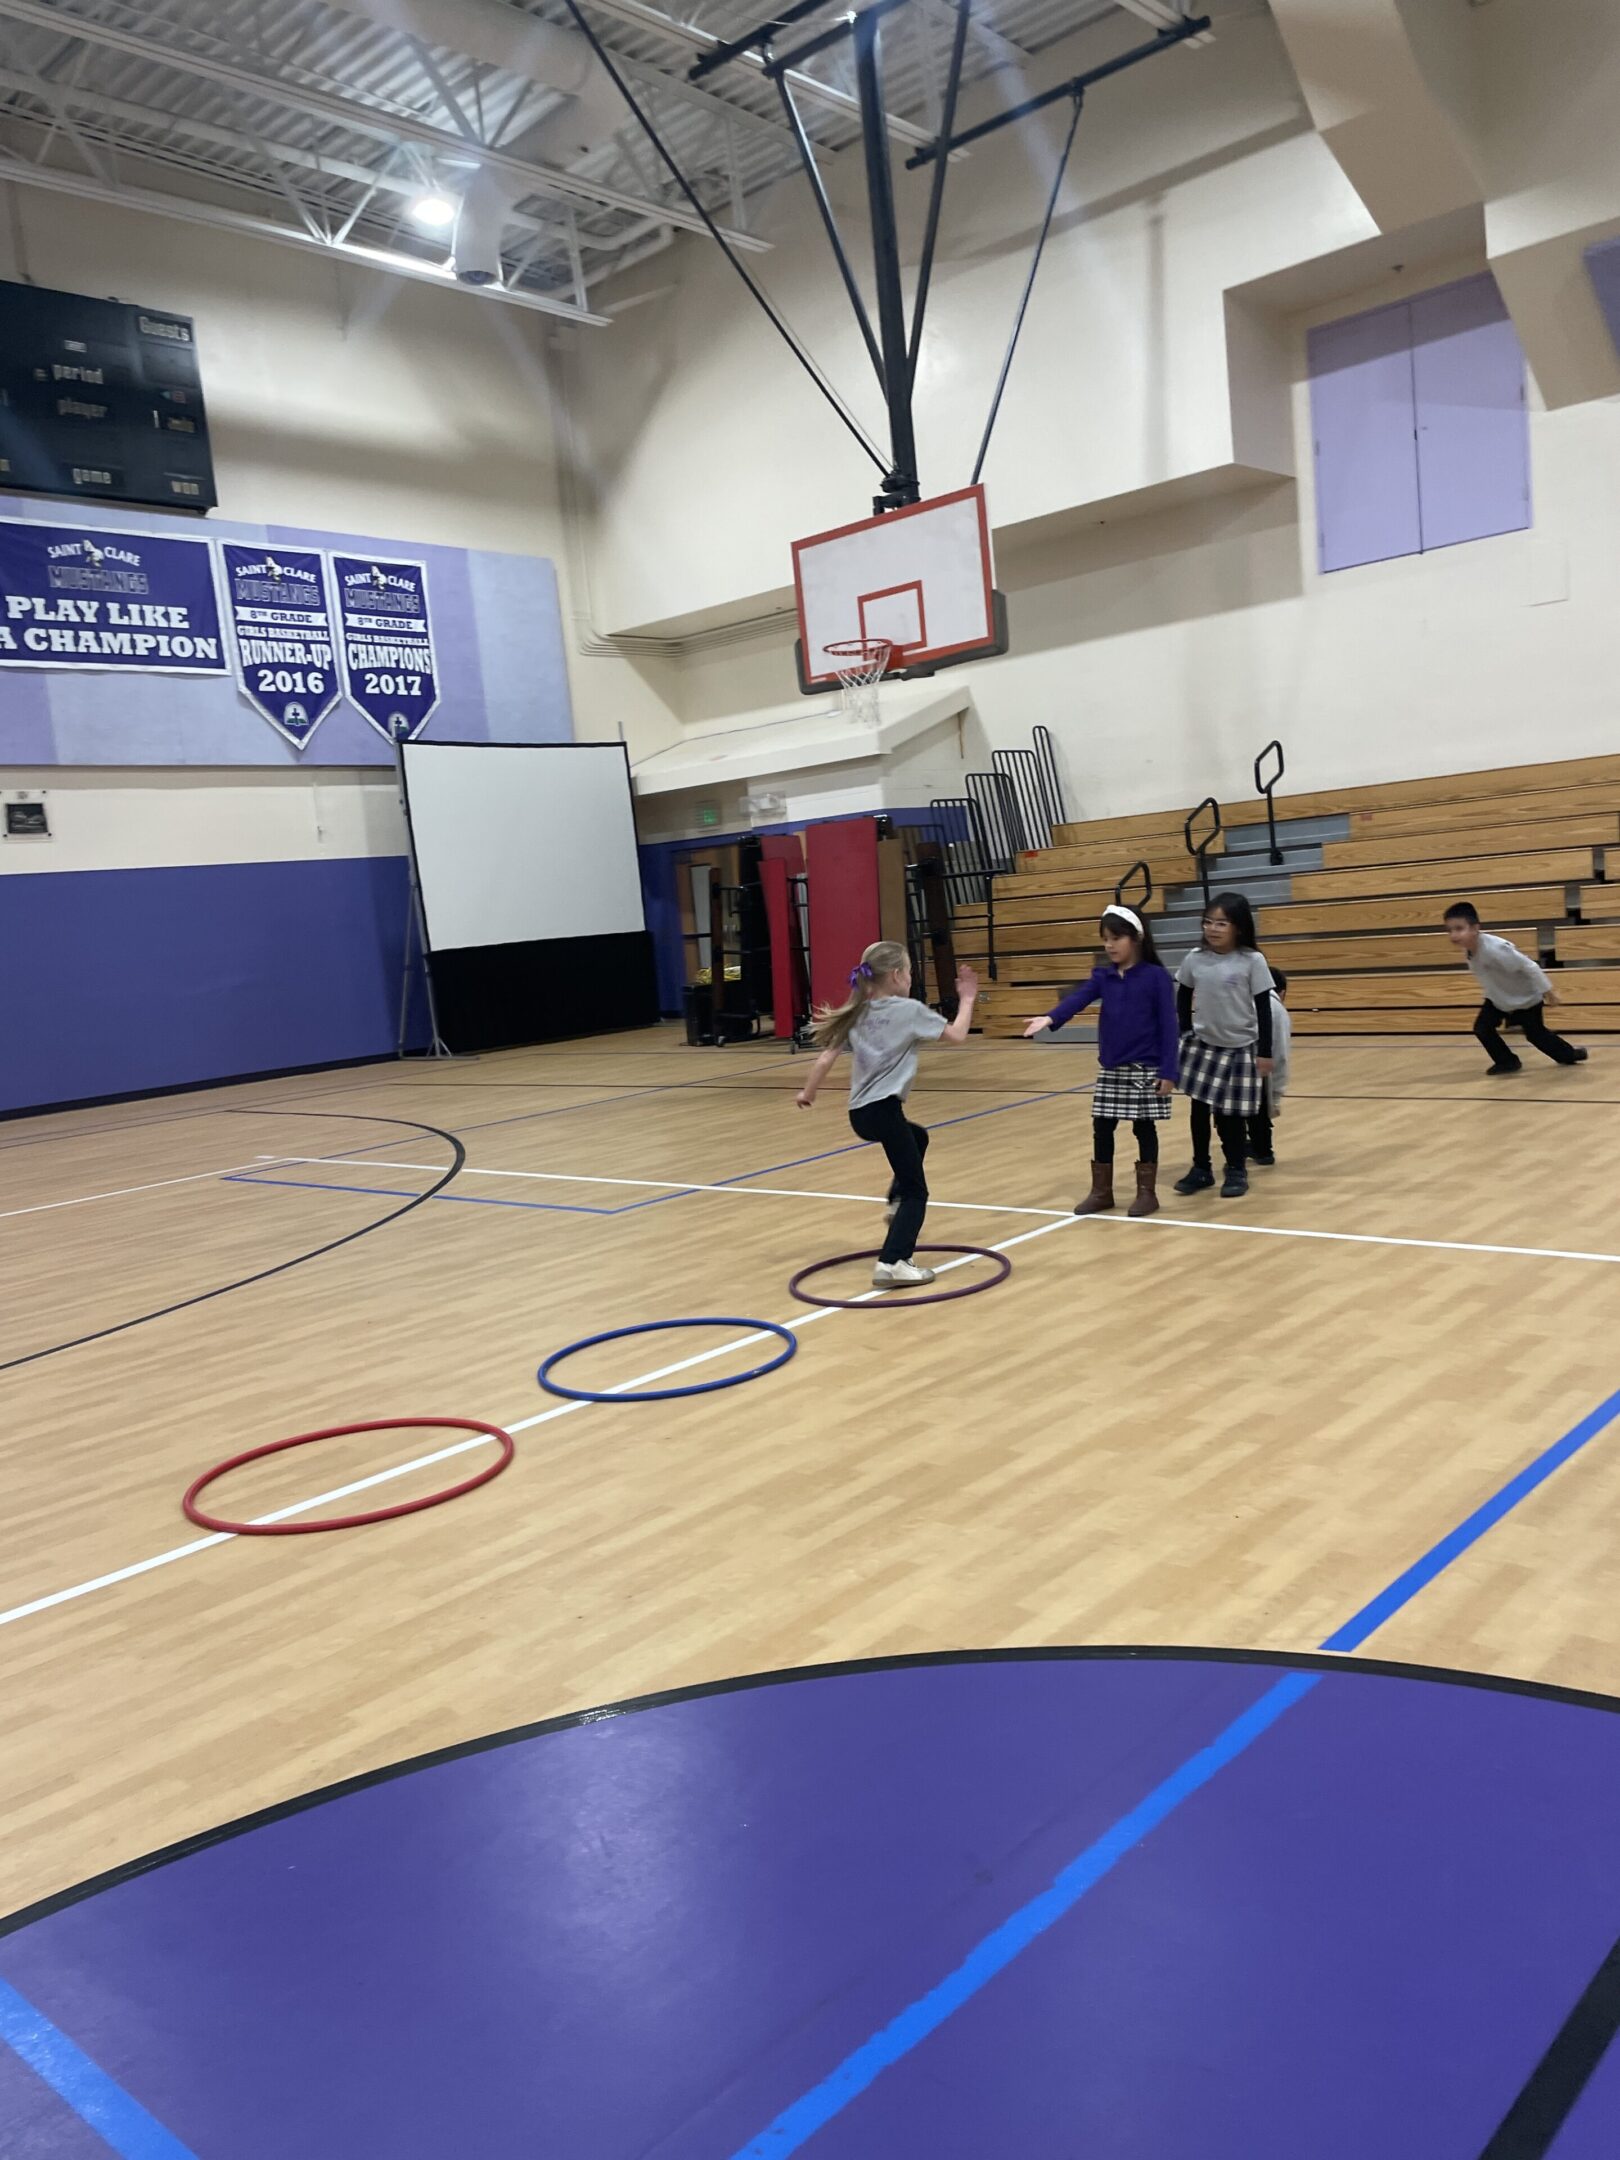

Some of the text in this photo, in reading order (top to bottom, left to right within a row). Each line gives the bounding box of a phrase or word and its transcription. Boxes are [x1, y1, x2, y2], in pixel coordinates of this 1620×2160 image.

[52, 364, 104, 385] period
[72, 467, 112, 485] game
[47, 543, 141, 567] SAINT CLARE
[48, 565, 150, 595] MUSTANGS
[235, 564, 317, 583] SAINT CLARE
[344, 572, 417, 592] SAINT CLARE
[234, 578, 321, 607] MUSTANGS
[343, 587, 421, 614] MUSTANGS
[5, 595, 190, 629] PLAY LIKE
[271, 611, 313, 624] GRADE
[375, 618, 414, 630] GRADE
[0, 626, 219, 659] A CHAMPION
[237, 624, 330, 641] GIRLS BASKETBALL
[345, 632, 373, 643] GIRLS
[238, 639, 333, 671] RUNNER-UP
[348, 642, 432, 675] CHAMPIONS
[257, 669, 325, 694] 2016
[364, 672, 422, 696] 2017
